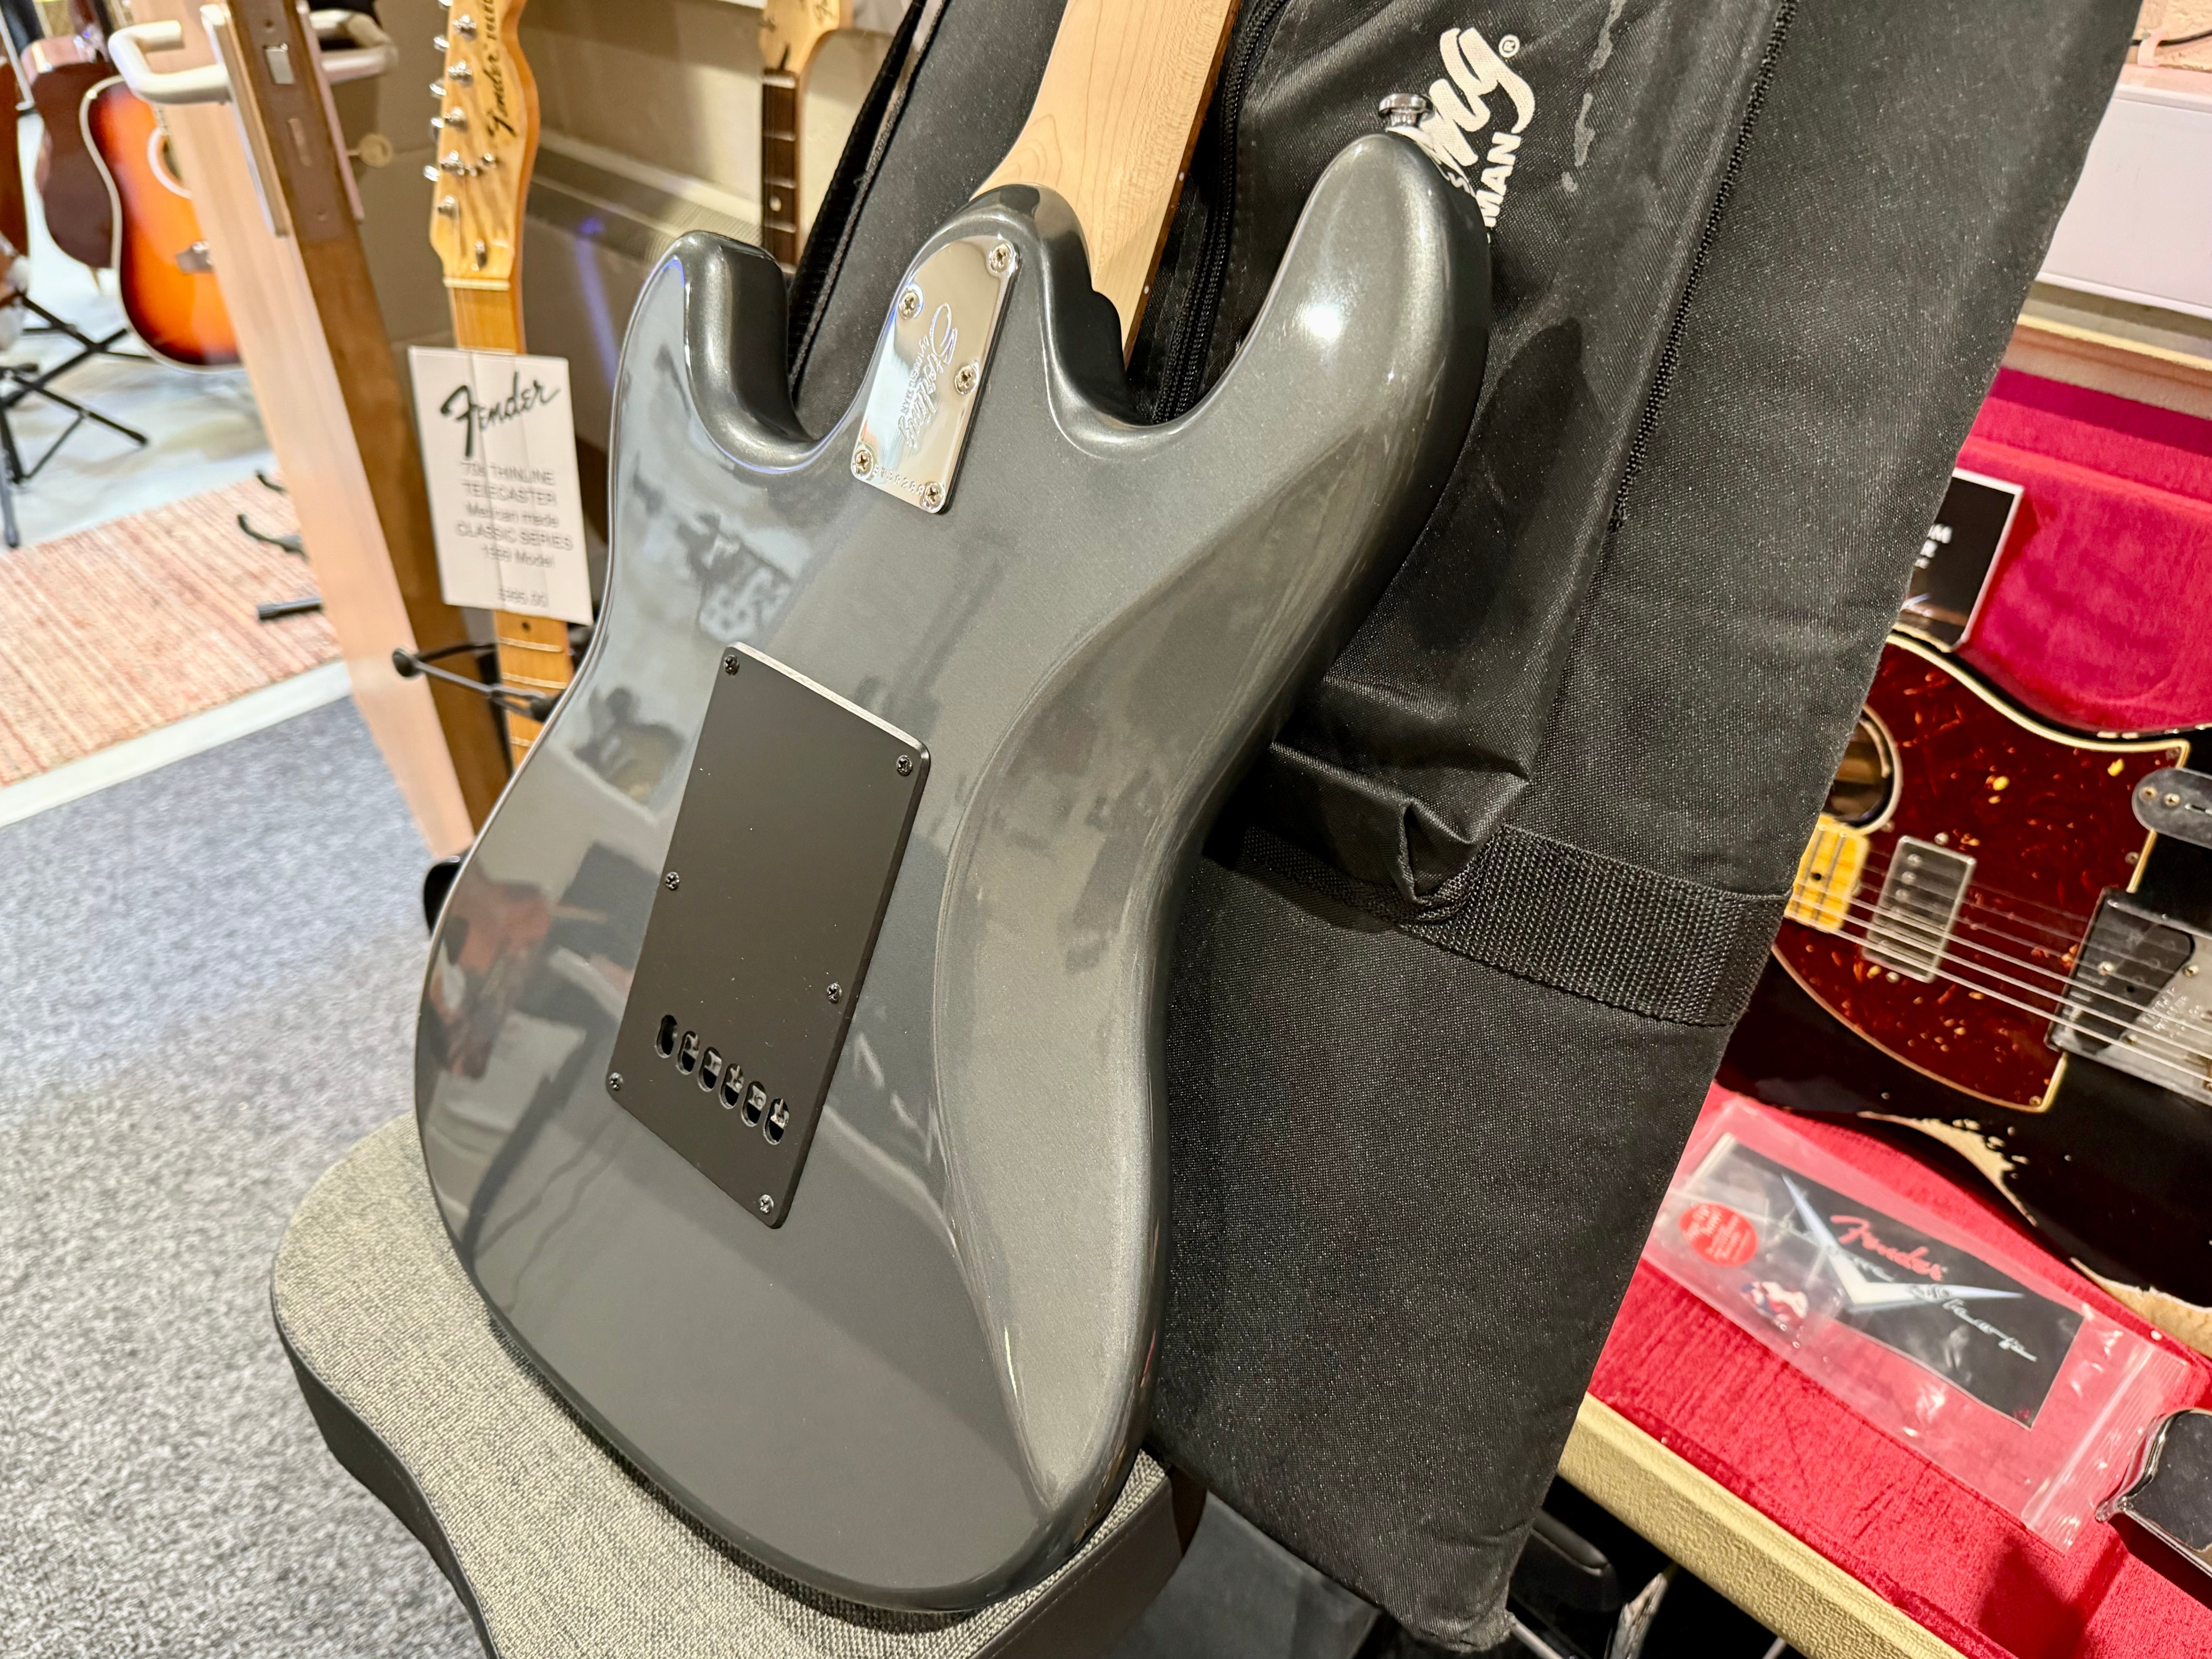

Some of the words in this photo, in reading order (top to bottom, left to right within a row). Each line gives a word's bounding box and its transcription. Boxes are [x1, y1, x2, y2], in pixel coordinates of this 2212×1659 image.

[898, 303, 957, 449] Sterling
[440, 371, 562, 457] Fender
[900, 388, 914, 415] MAN
[488, 464, 555, 486] THINLINE
[462, 481, 557, 506] TELECASTER
[455, 520, 518, 543] CLASSIC
[519, 529, 574, 551] SERIES
[1830, 1215, 1942, 1281] Fender
